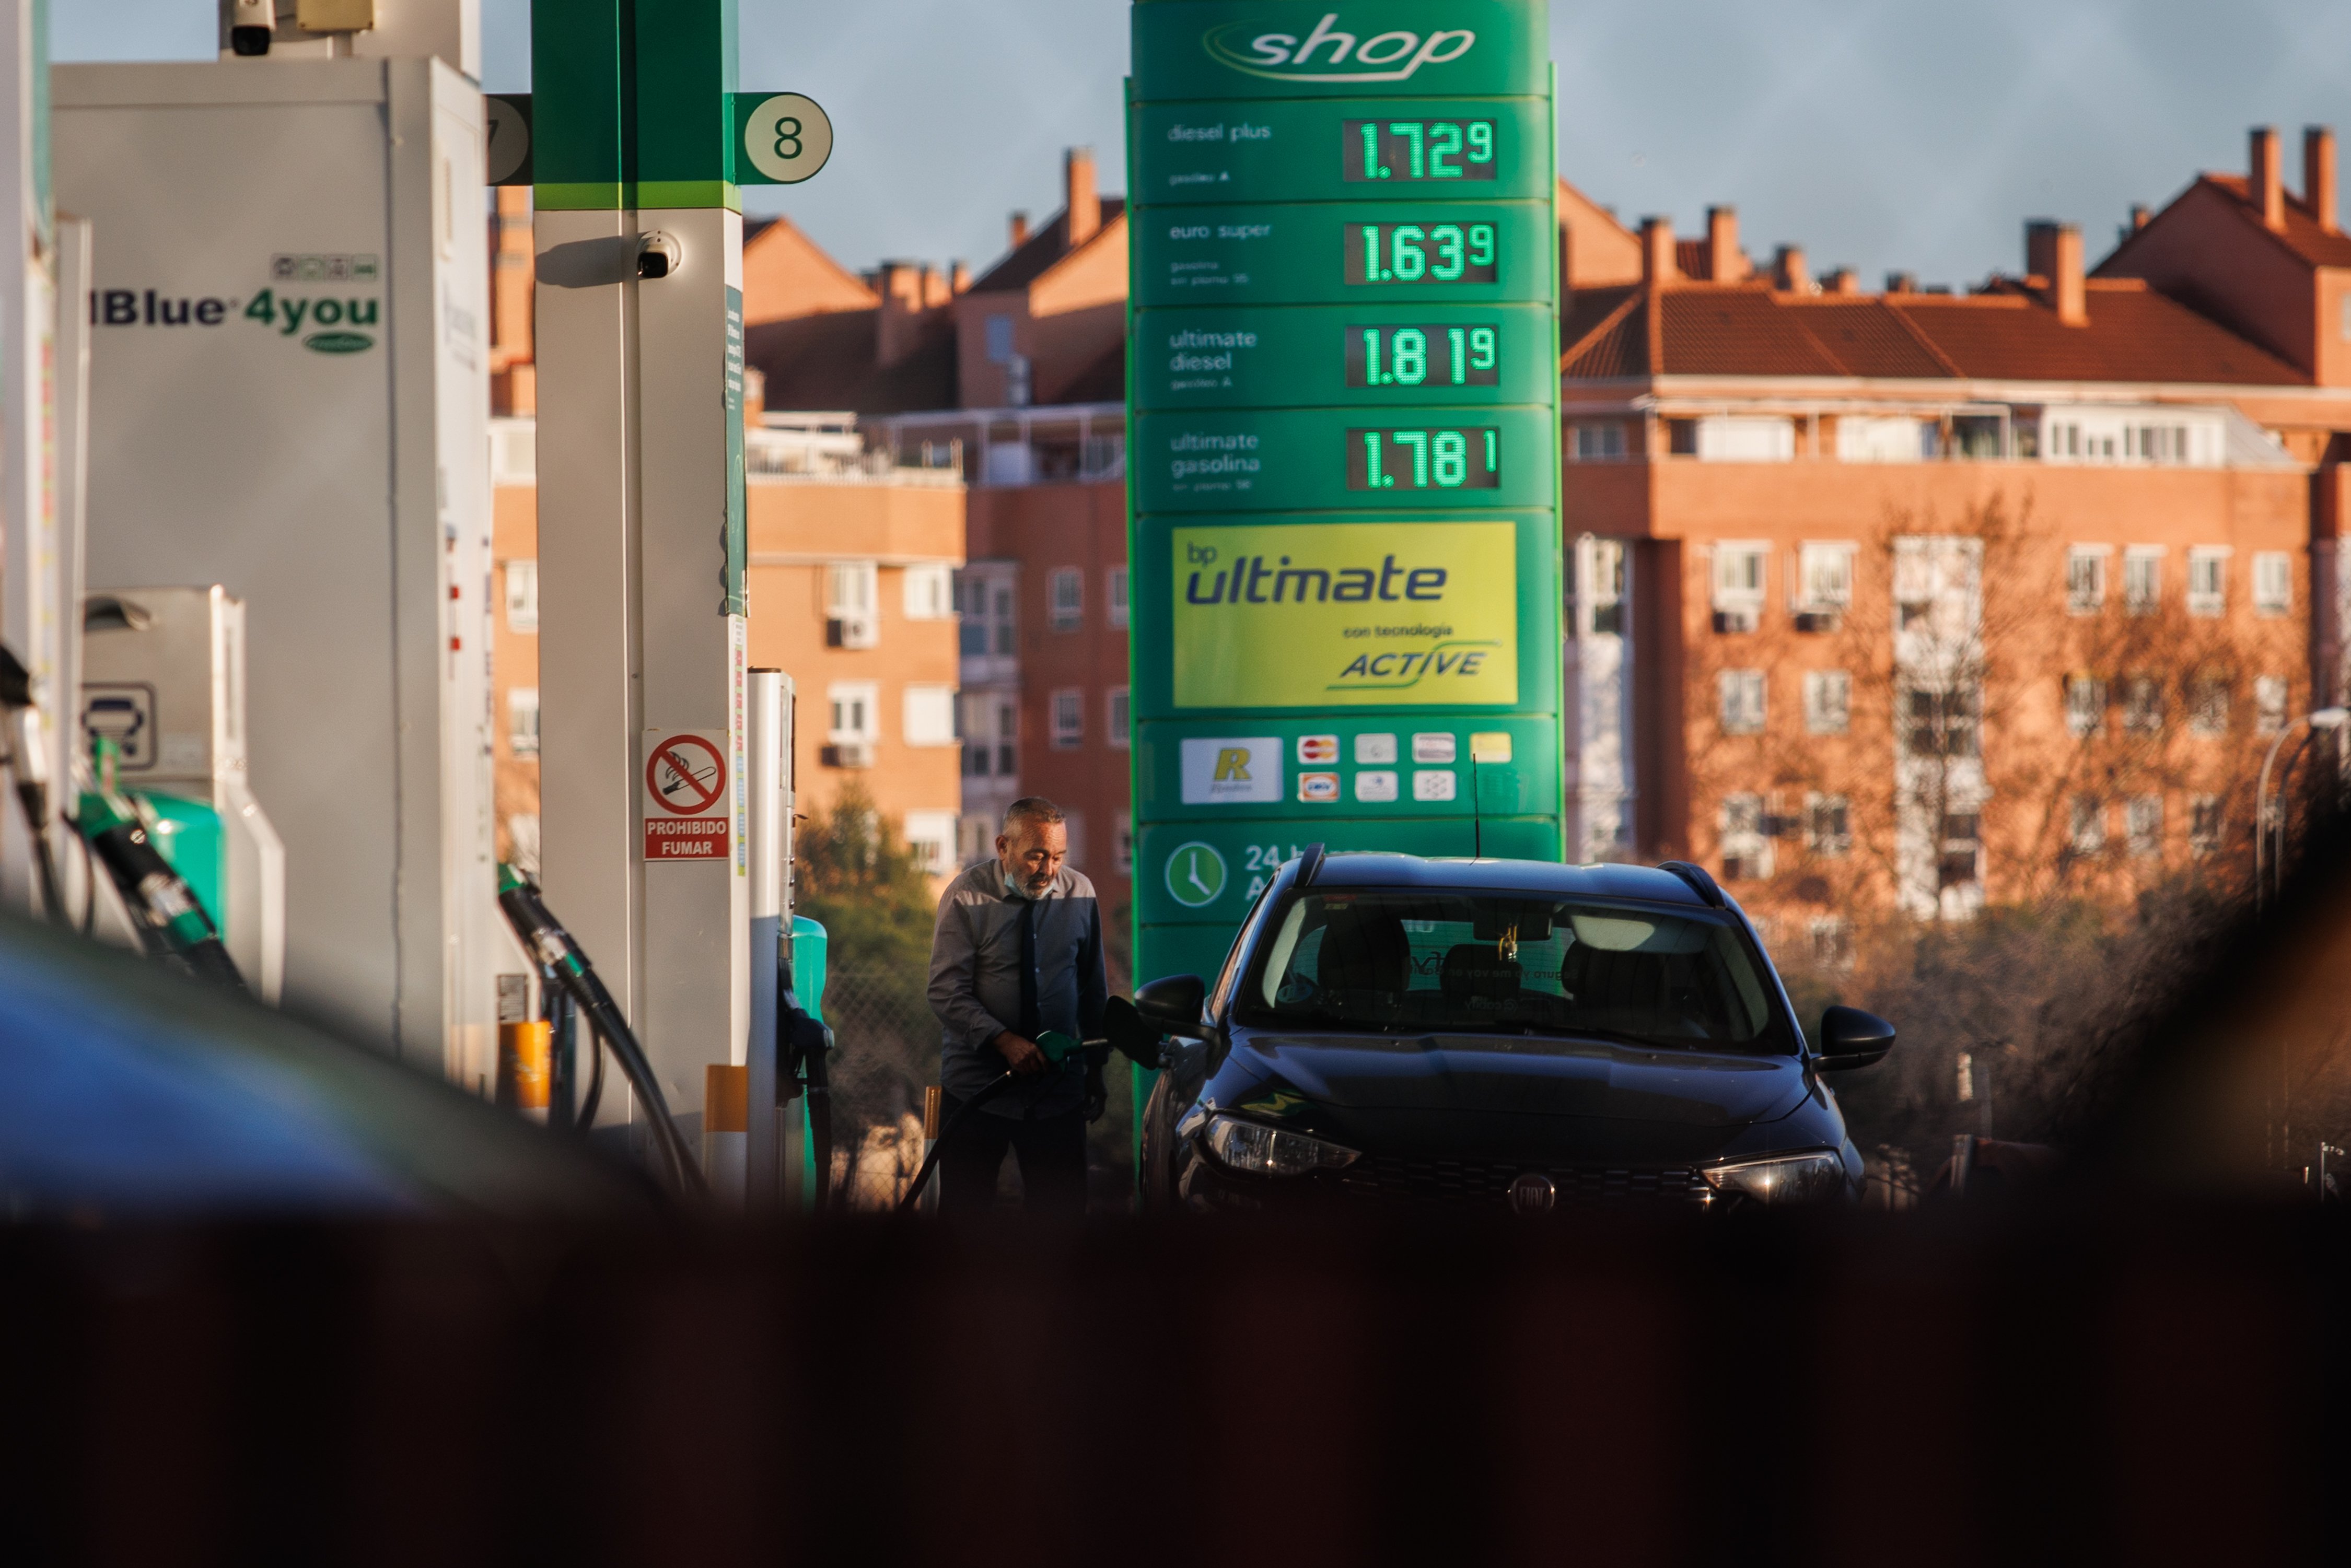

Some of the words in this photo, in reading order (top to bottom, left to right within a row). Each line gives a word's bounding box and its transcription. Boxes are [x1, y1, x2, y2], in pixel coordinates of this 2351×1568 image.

[1251, 13, 1476, 81] shop
[774, 116, 804, 160] 8
[1168, 123, 1224, 141] diesel
[1230, 122, 1271, 142] plus
[1361, 121, 1493, 179] 1.729
[1170, 226, 1211, 239] euro
[1217, 224, 1272, 240] super
[1363, 224, 1495, 282] 1.639
[90, 289, 226, 326] Blue
[244, 288, 379, 335] 4you
[1170, 329, 1258, 349] ultimate
[1170, 350, 1232, 371] diesel
[1171, 431, 1259, 451] ultimate
[1172, 454, 1261, 478] gasolina
[1187, 541, 1217, 568] bp
[1186, 555, 1448, 604] ultimate
[1343, 627, 1370, 638] con
[1340, 651, 1487, 678] ACTIVE
[1215, 747, 1252, 781] R
[647, 821, 727, 836] PROHIBIDO
[661, 841, 713, 856] FUMAR
[1246, 845, 1281, 871] 24
[1519, 1186, 1546, 1207] FIAT
